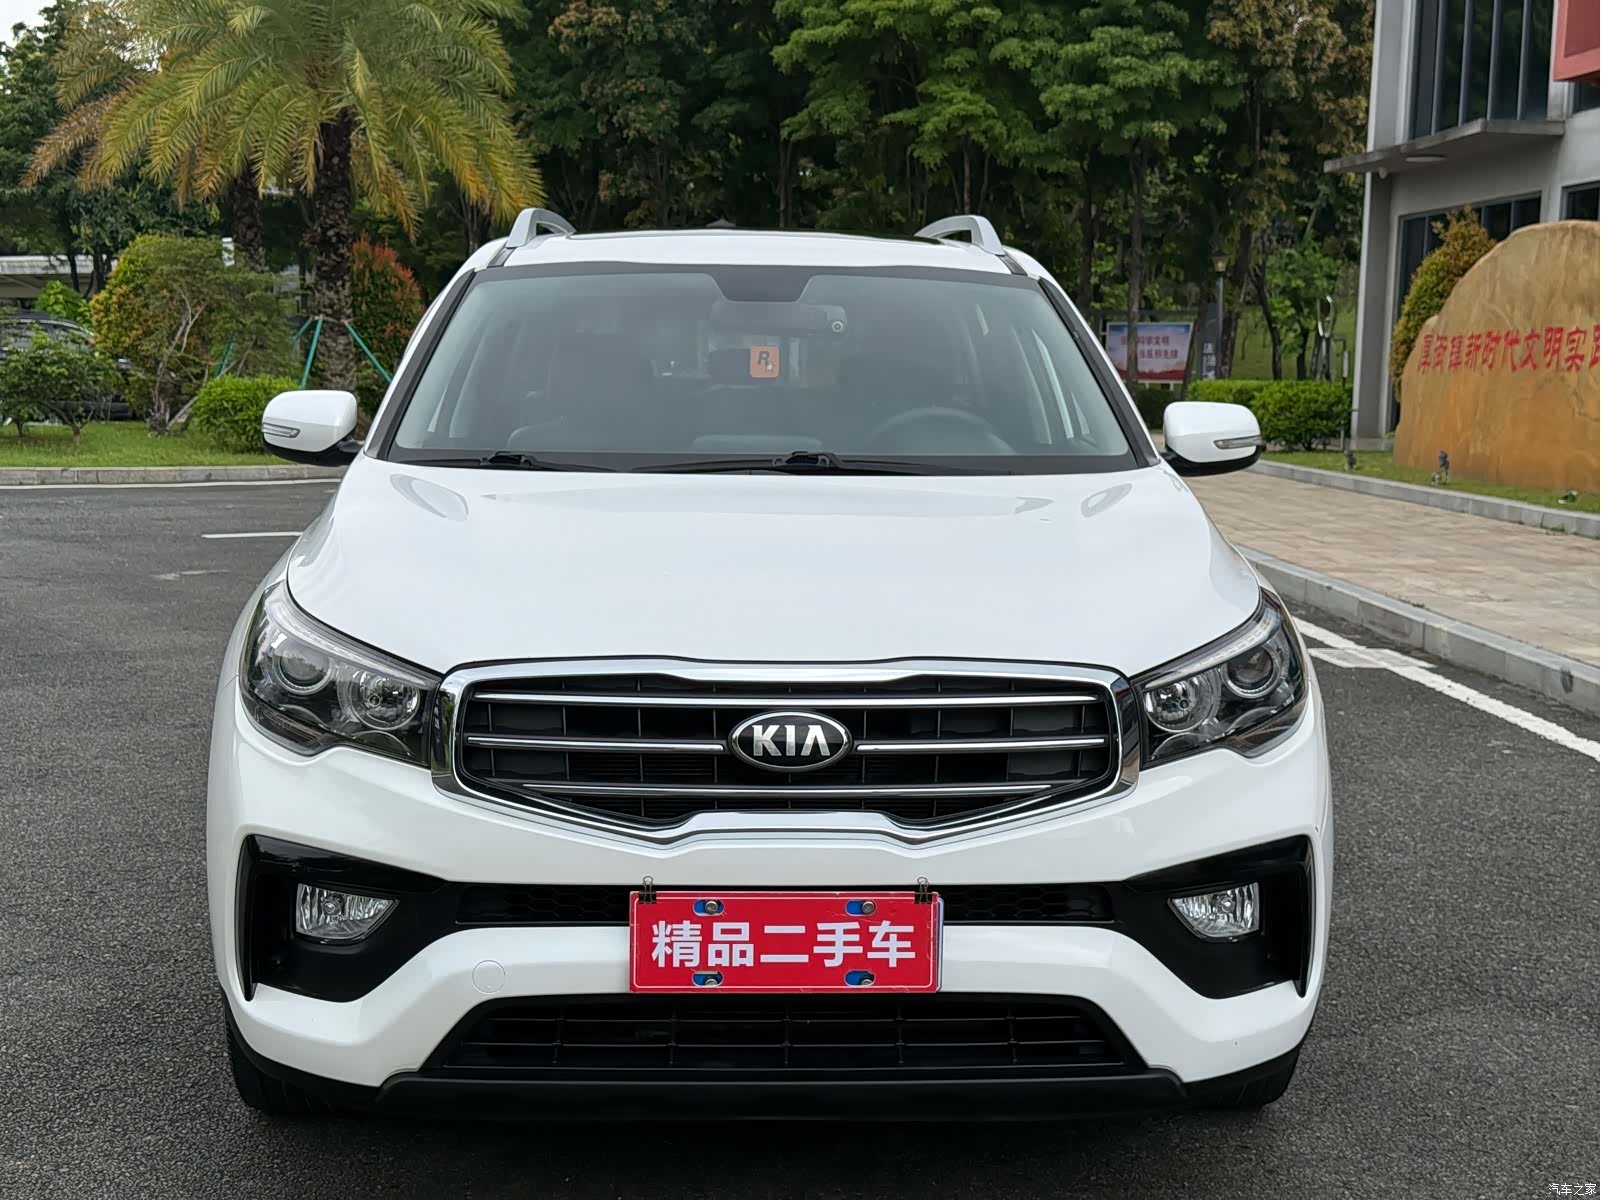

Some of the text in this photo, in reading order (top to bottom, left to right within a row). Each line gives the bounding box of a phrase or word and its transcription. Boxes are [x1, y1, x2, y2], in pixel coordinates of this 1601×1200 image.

[752, 724, 831, 757] KIA
[651, 919, 916, 968] 精品二手车
